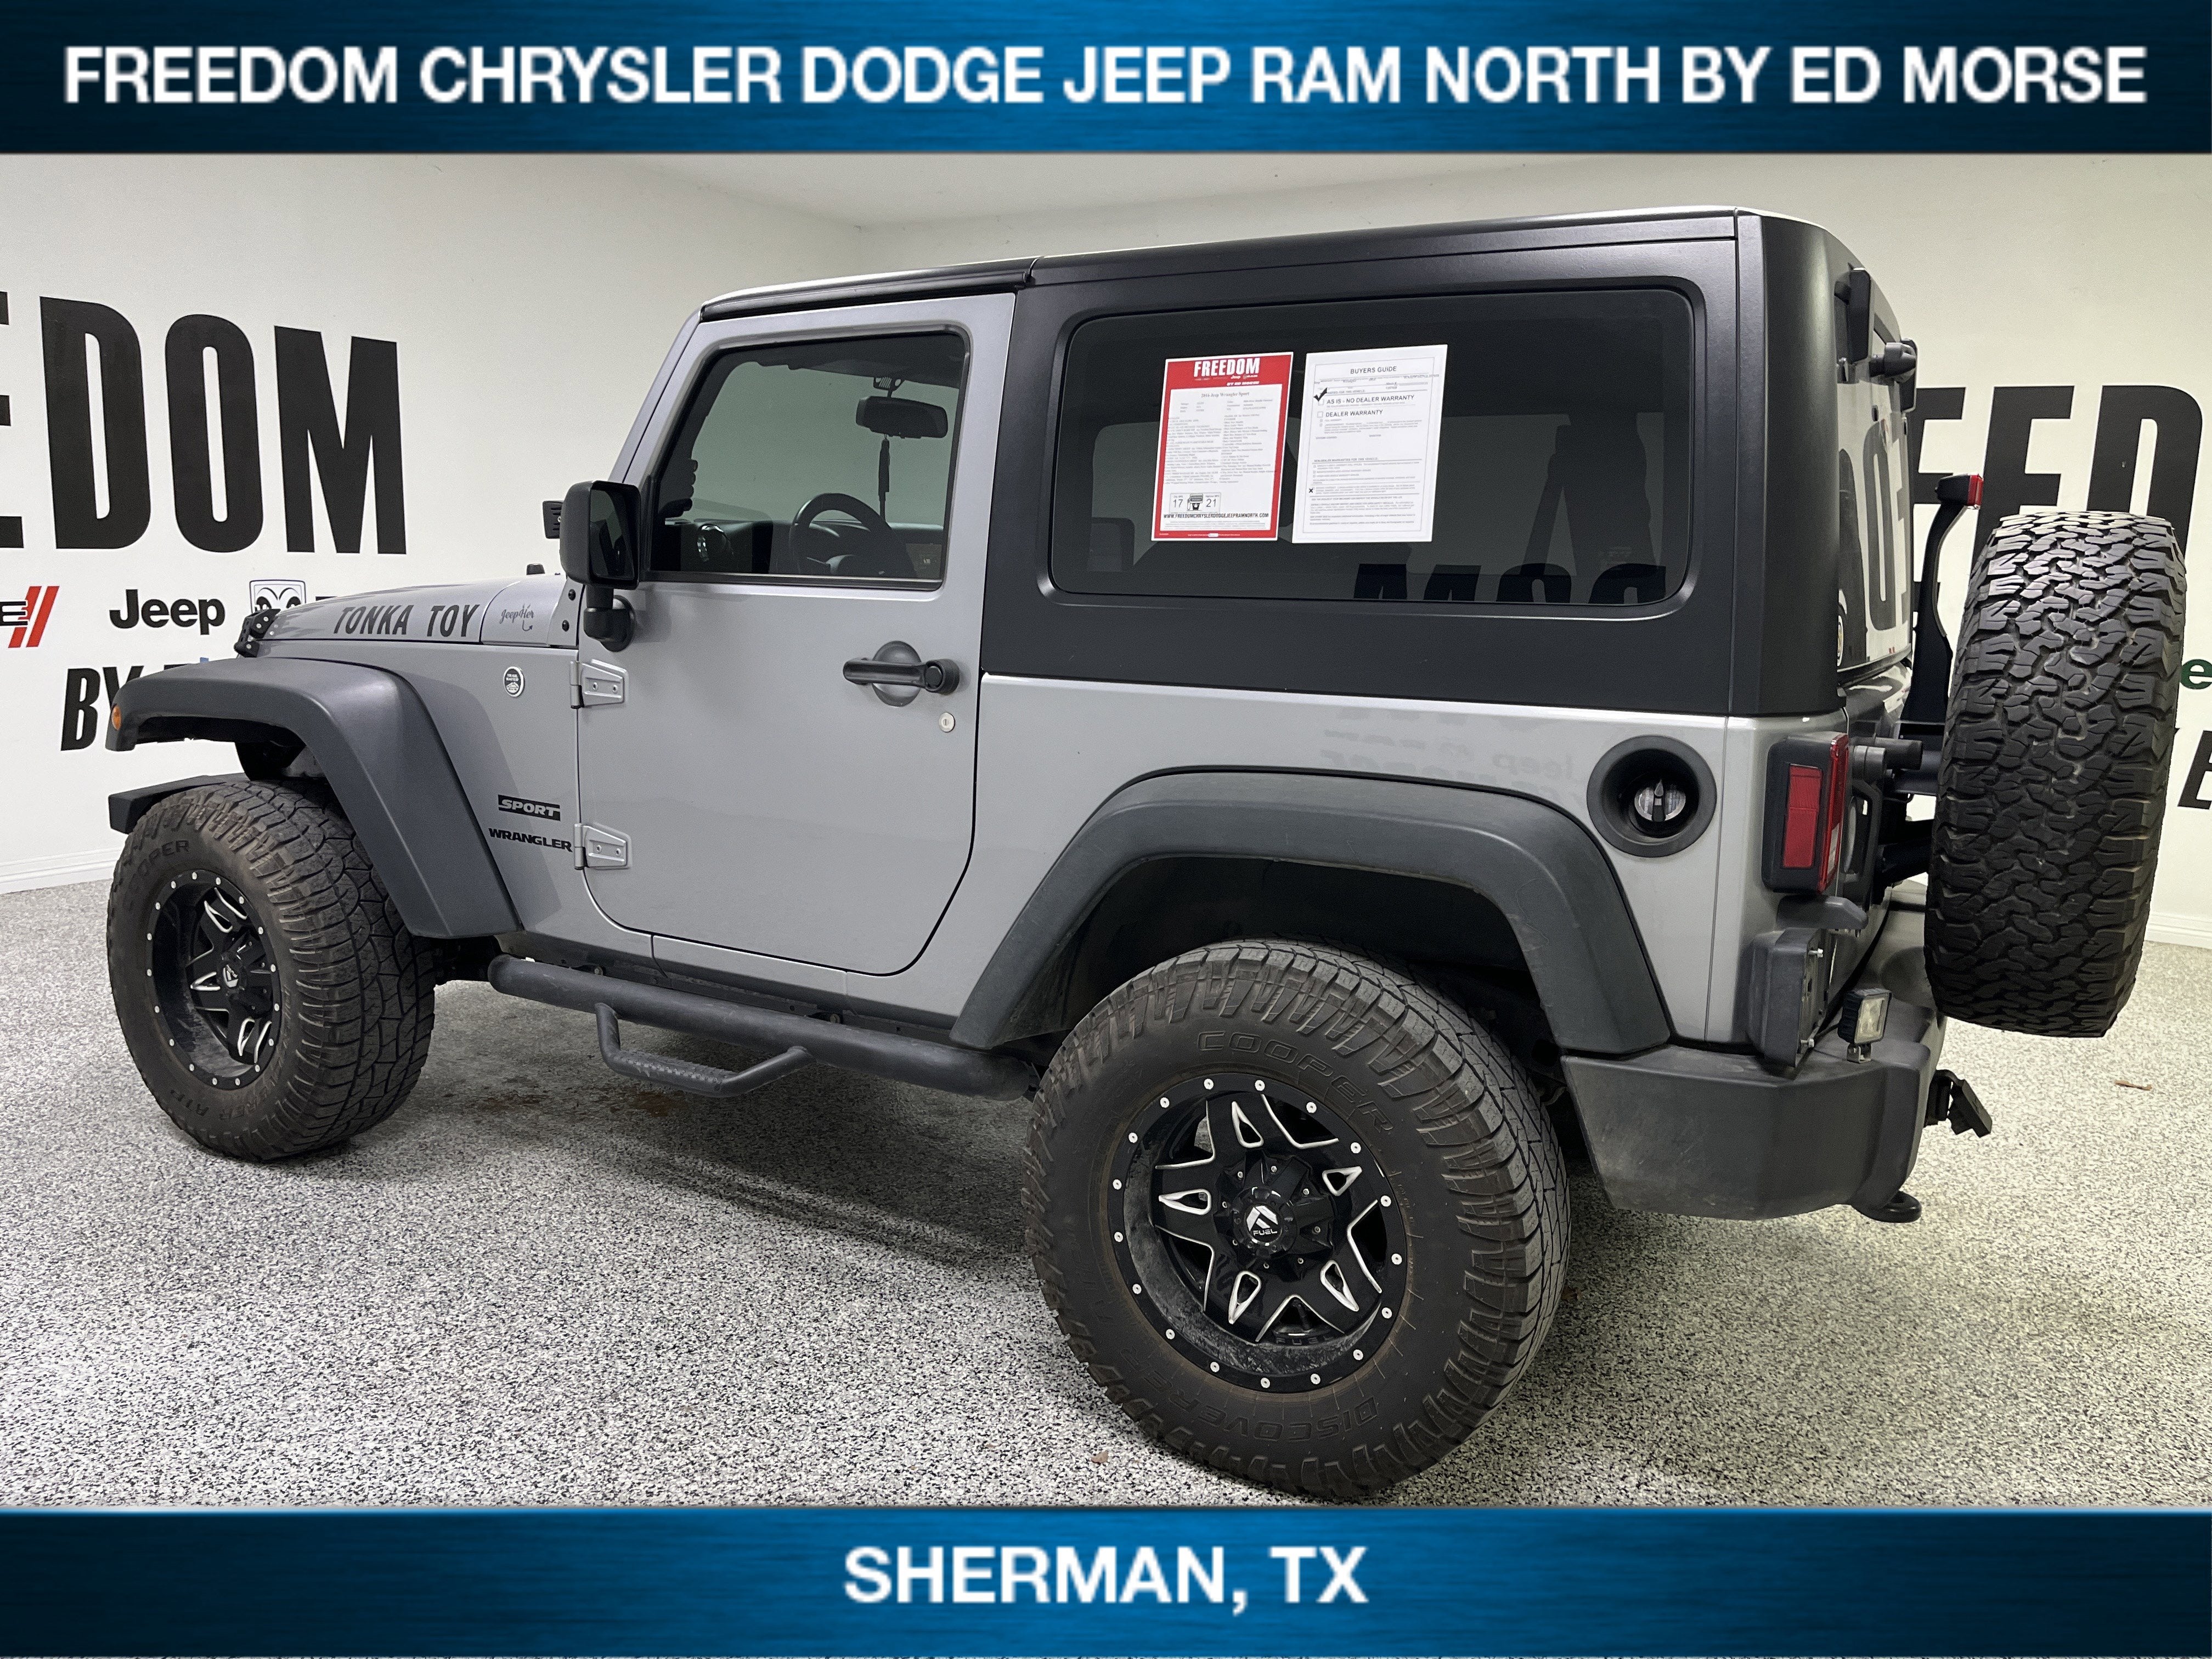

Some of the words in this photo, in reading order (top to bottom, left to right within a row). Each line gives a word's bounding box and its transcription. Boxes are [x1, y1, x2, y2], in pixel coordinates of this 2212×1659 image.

[1193, 358, 1261, 377] FREEDOM
[0, 291, 407, 554] DOM
[1173, 499, 1183, 508] 17
[1206, 498, 1216, 507] 21
[109, 589, 225, 635] Jeep
[333, 604, 414, 635] TONKA
[427, 604, 480, 637] TOY
[499, 799, 561, 817] SPORT
[488, 827, 573, 853] WRANGLER
[1197, 1030, 1394, 1136] COOPER
[1252, 1228, 1278, 1237] FUEL
[1119, 1347, 1379, 1444] DISCOVERER
